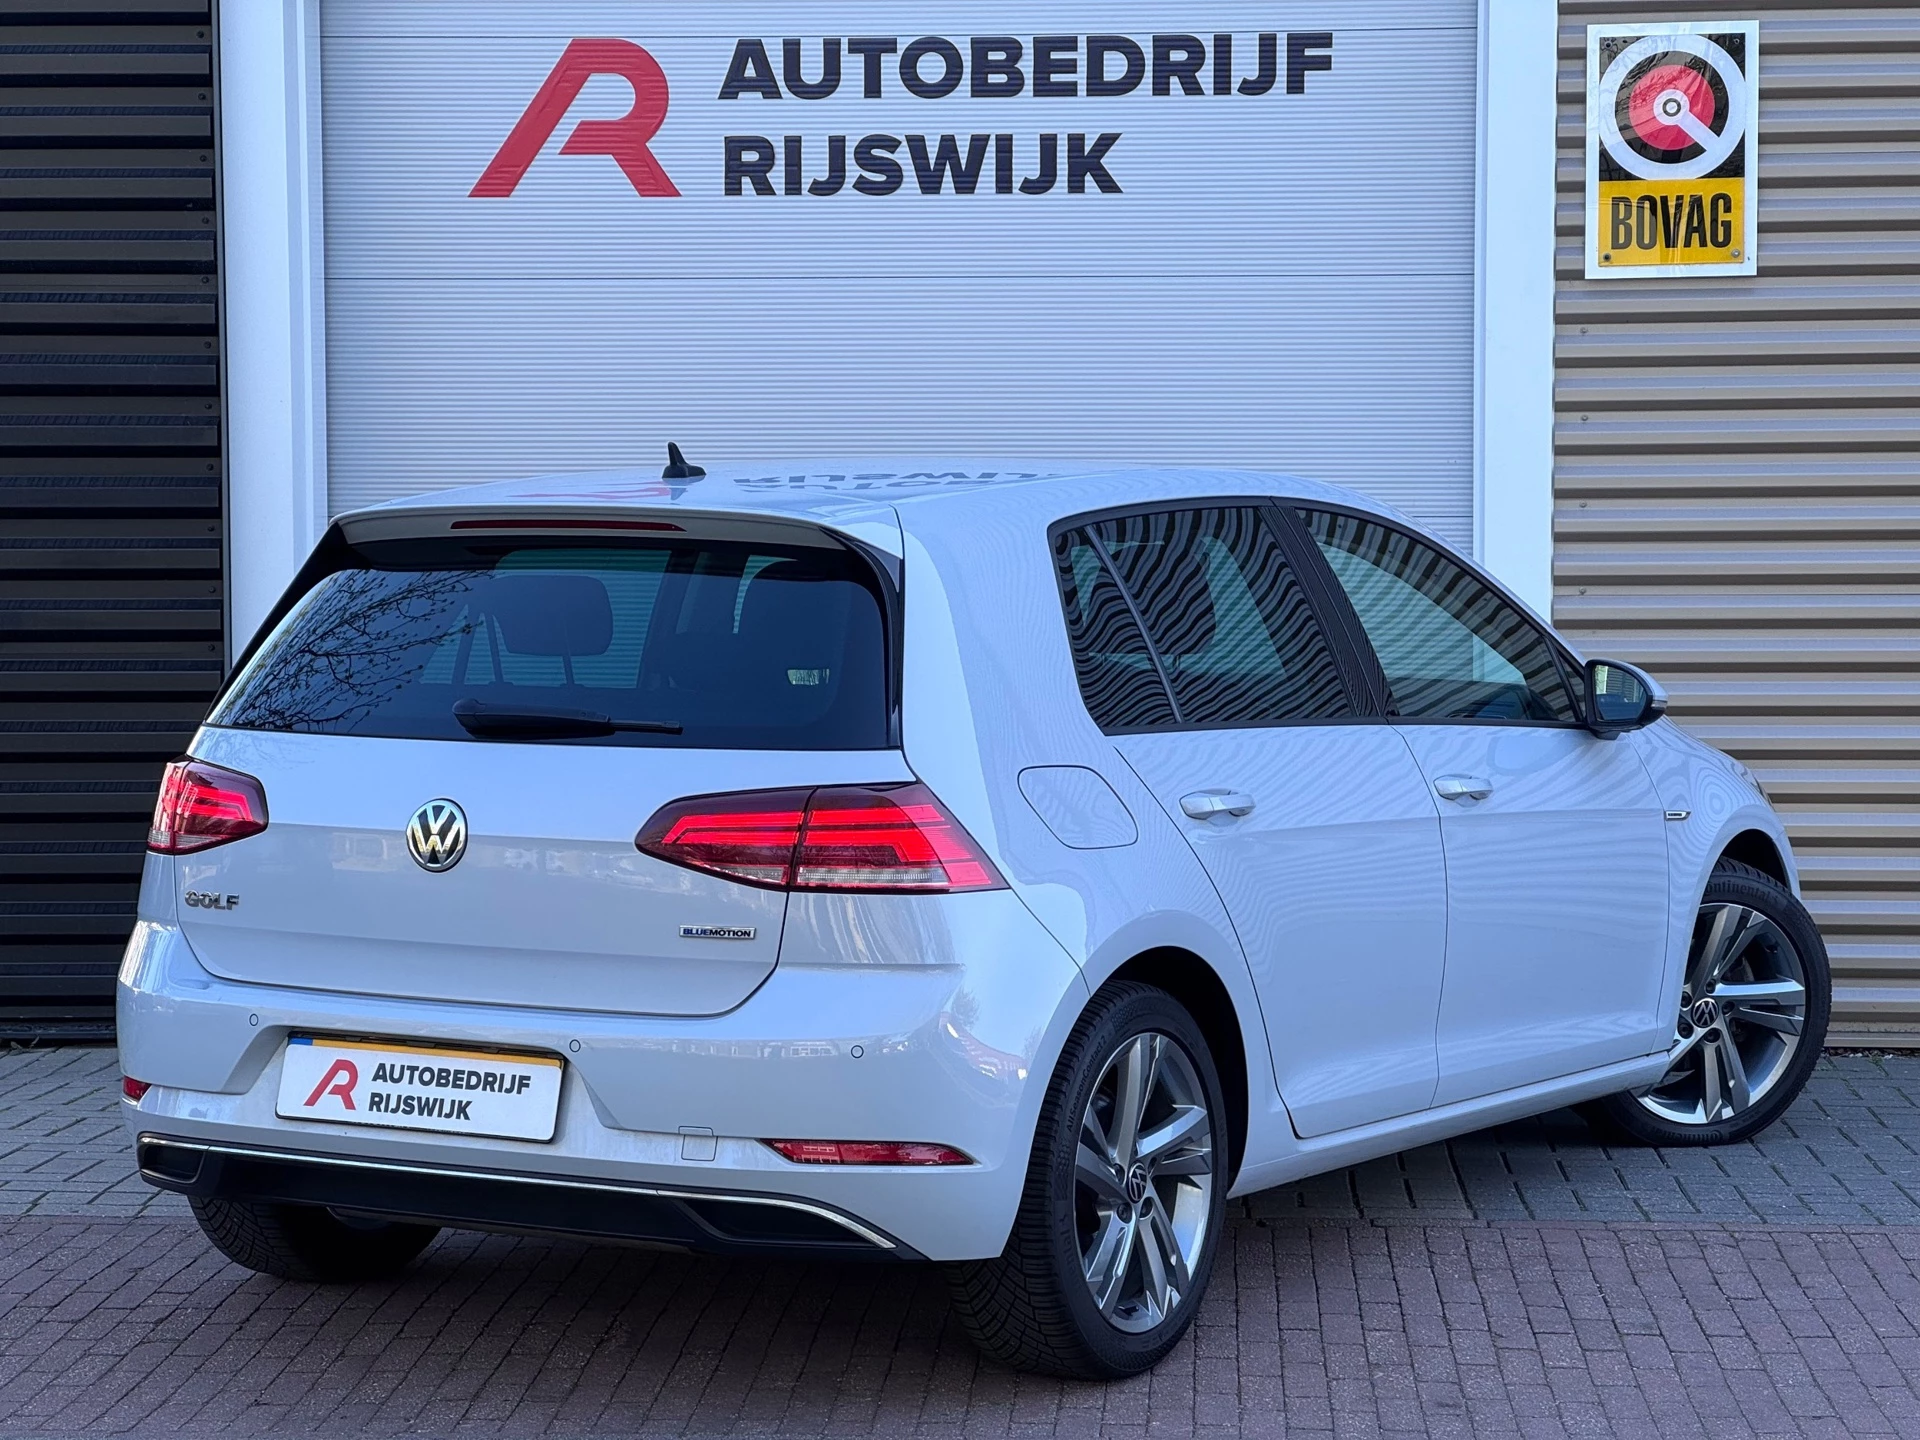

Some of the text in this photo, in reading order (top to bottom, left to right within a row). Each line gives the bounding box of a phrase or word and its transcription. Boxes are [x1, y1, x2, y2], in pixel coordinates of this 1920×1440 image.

[717, 32, 1334, 100] AUTOBEDRIJF
[724, 133, 1123, 197] RIJSWIJK
[1611, 193, 1732, 250] BOVAG
[184, 890, 240, 911] GOLF
[682, 928, 751, 938] BLUEMOTION
[371, 1062, 532, 1095] AUTOBEDRIJF
[368, 1091, 473, 1121] RIJSWIJK
